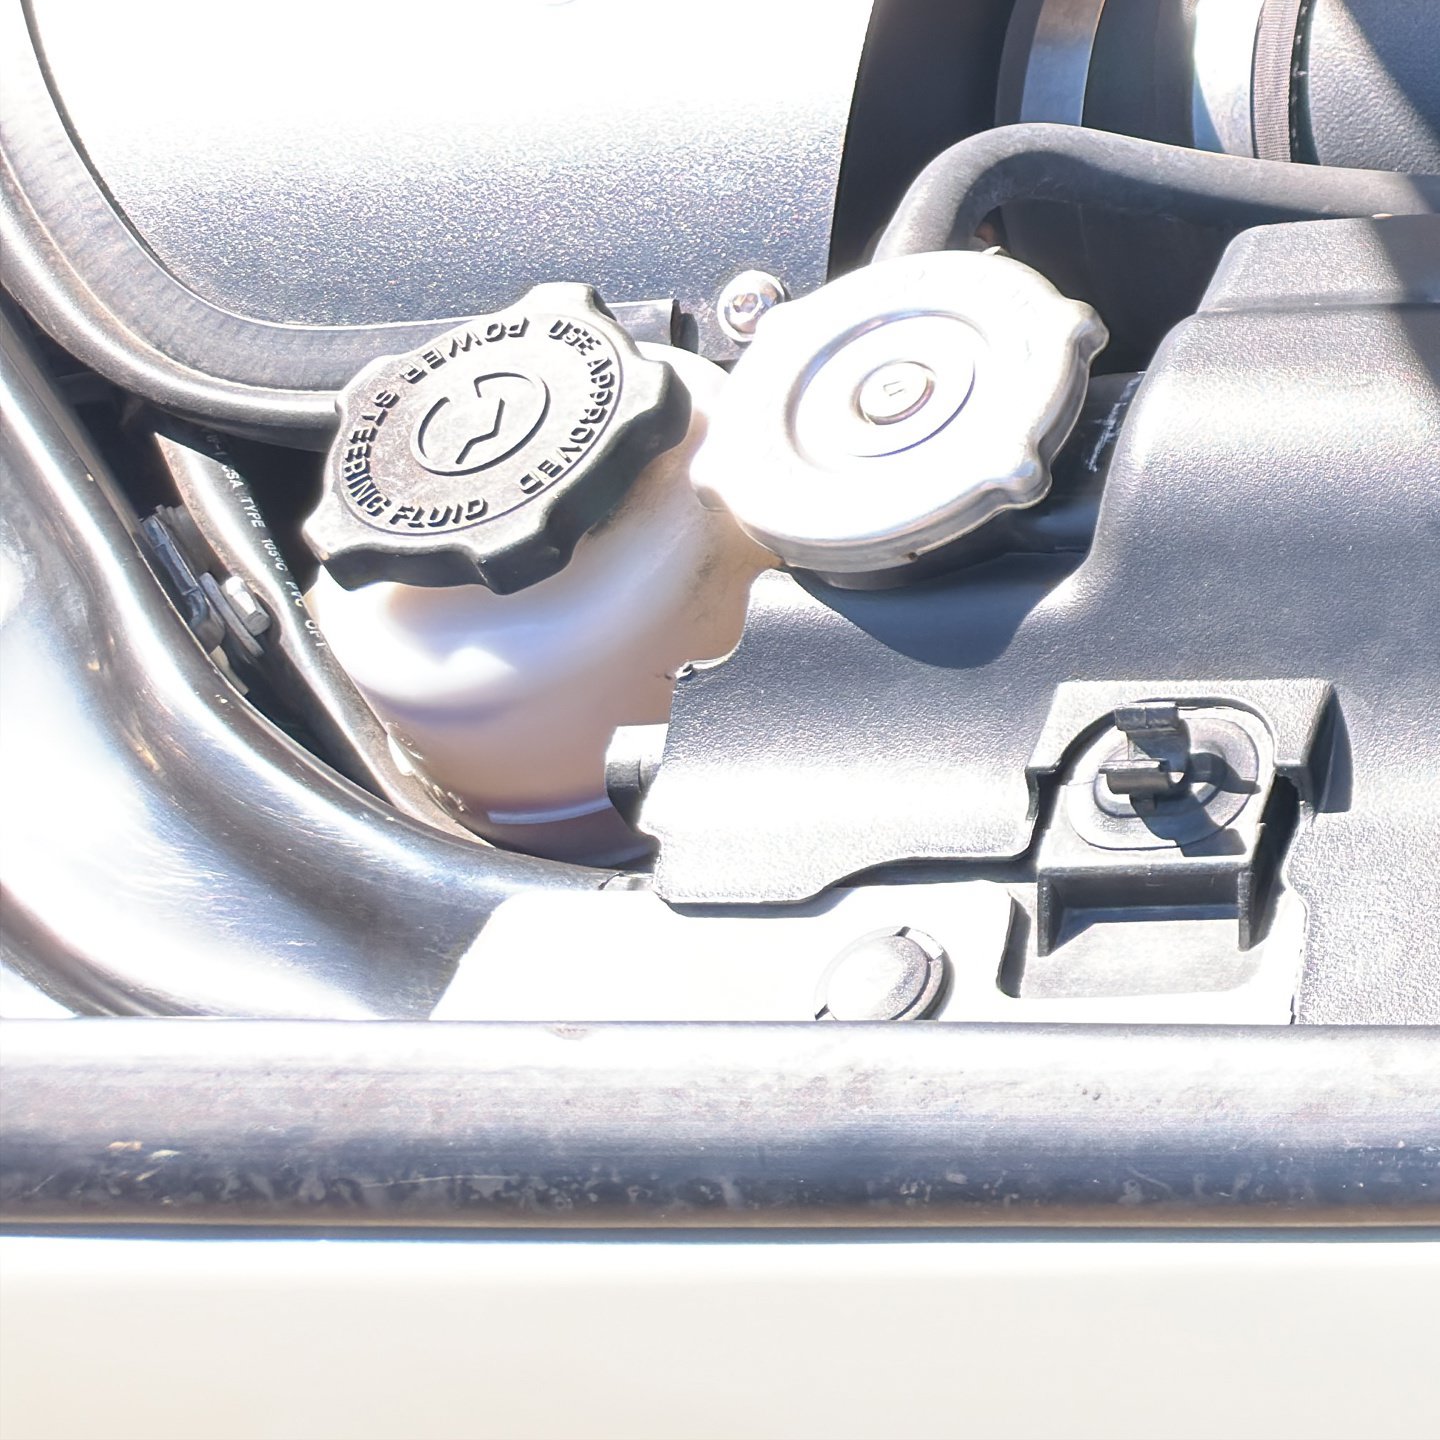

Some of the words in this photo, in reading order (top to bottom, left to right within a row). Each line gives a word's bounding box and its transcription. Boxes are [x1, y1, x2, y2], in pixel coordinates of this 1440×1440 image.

[399, 317, 530, 384] POWER
[548, 319, 602, 356] USE
[519, 356, 616, 495] APPROVED
[344, 388, 400, 518] STEERING
[240, 496, 266, 528] TYPE
[389, 497, 489, 528] FLUID
